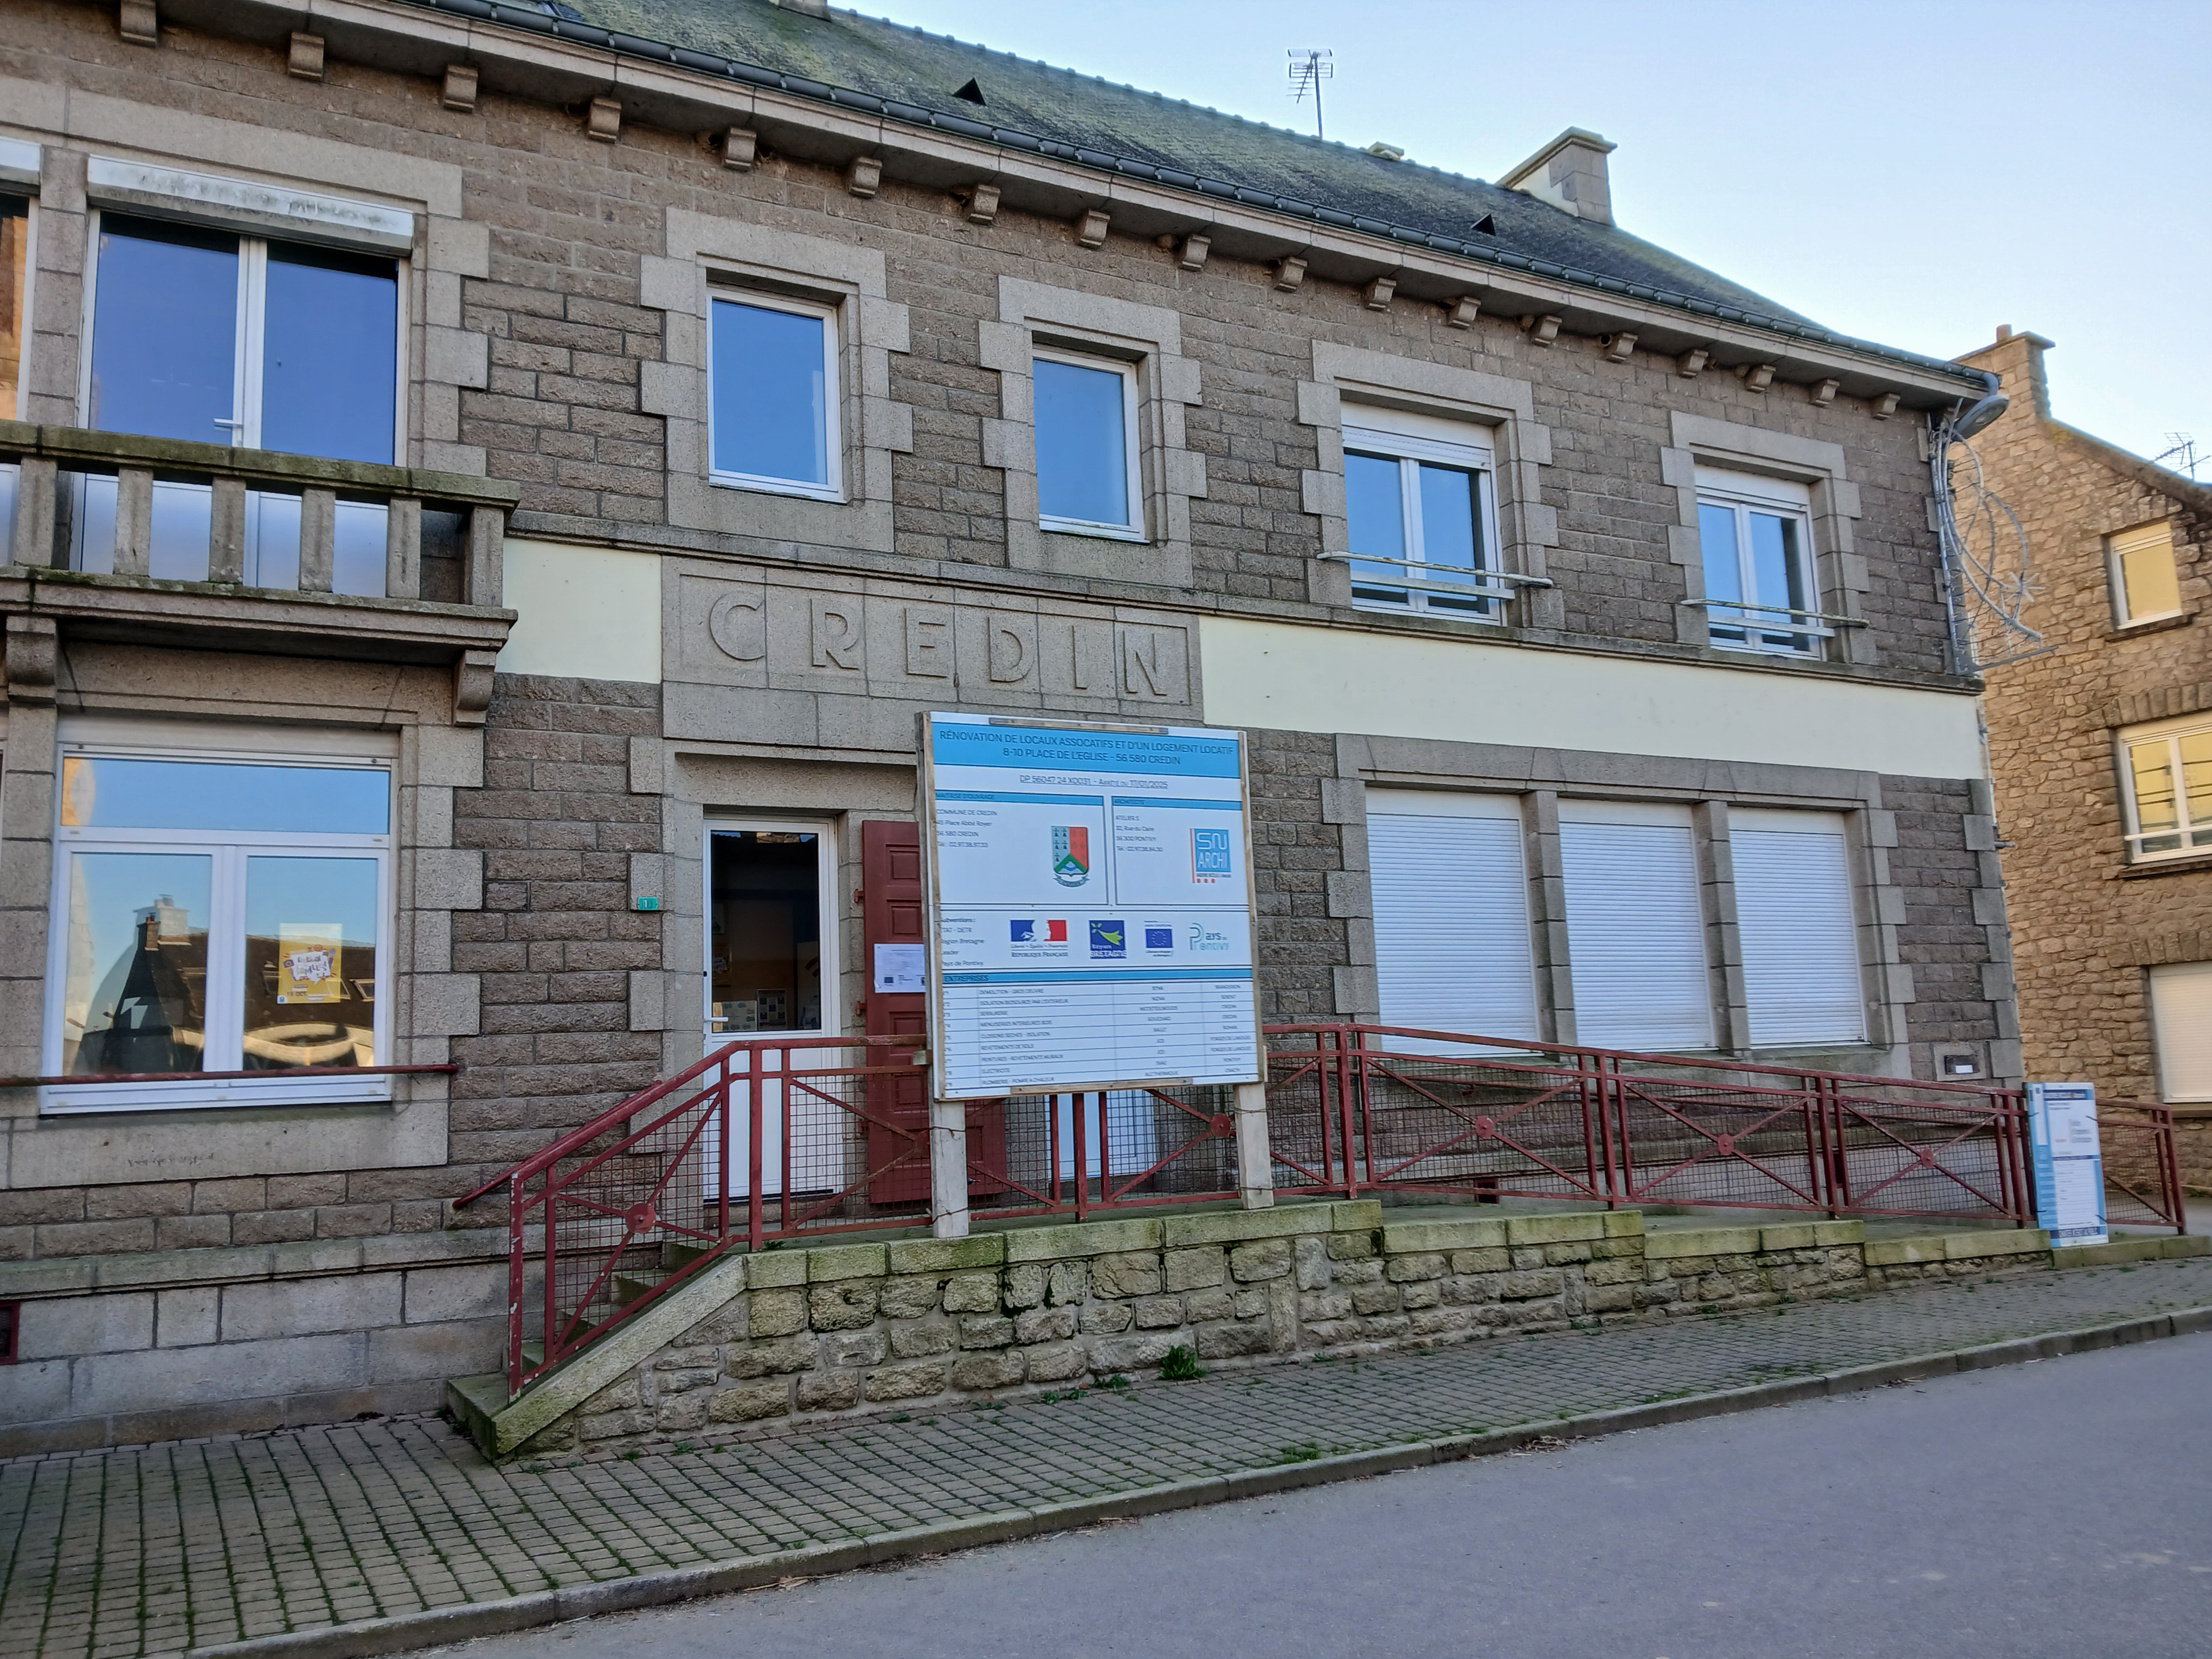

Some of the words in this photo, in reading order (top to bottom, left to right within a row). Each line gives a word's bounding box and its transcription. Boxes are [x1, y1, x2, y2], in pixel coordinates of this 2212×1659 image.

[709, 591, 1167, 696] CREDIN
[940, 729, 1002, 742] RÉNOVATION
[1005, 735, 1018, 743] DE
[1020, 736, 1057, 745] LOCAUX
[1116, 741, 1126, 749] ET
[1128, 741, 1150, 750] D'UN
[1151, 743, 1199, 753] LOGEMENT
[1200, 745, 1233, 755] LOCATIF
[1003, 748, 1023, 756] 8-10
[1026, 749, 1055, 758] PLACE
[1057, 750, 1069, 759] DE
[1116, 753, 1127, 762] 56
[1129, 754, 1147, 763] 580
[1149, 755, 1181, 764] CREDIN
[1197, 852, 1229, 869] ARCHI
